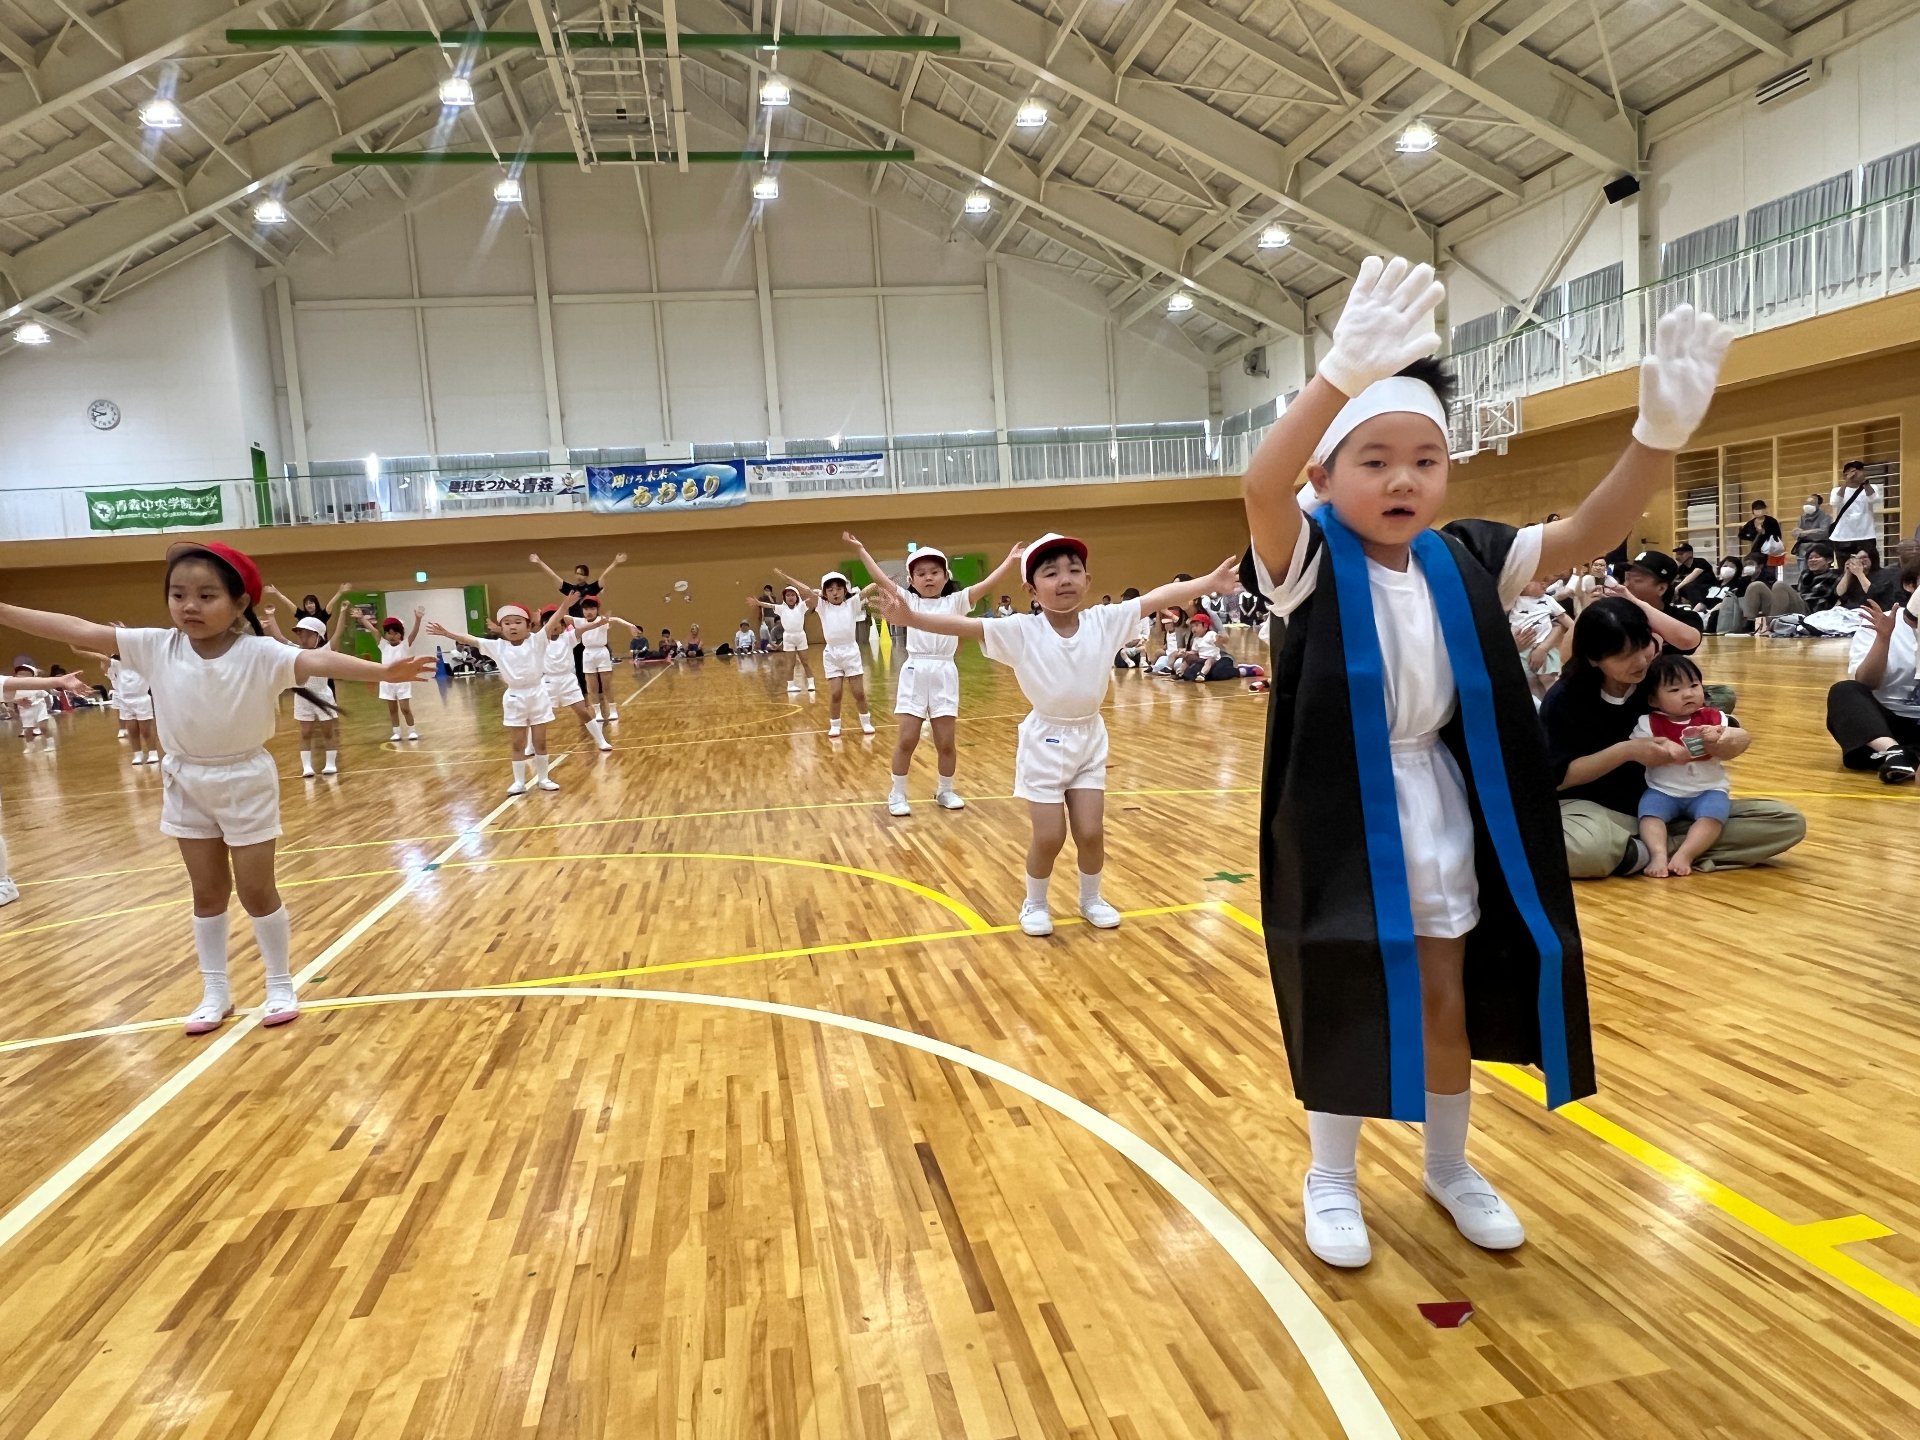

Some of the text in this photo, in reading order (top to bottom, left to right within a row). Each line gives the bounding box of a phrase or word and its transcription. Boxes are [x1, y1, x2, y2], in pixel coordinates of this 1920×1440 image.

[115, 495, 218, 513] 青森中央学院大学
